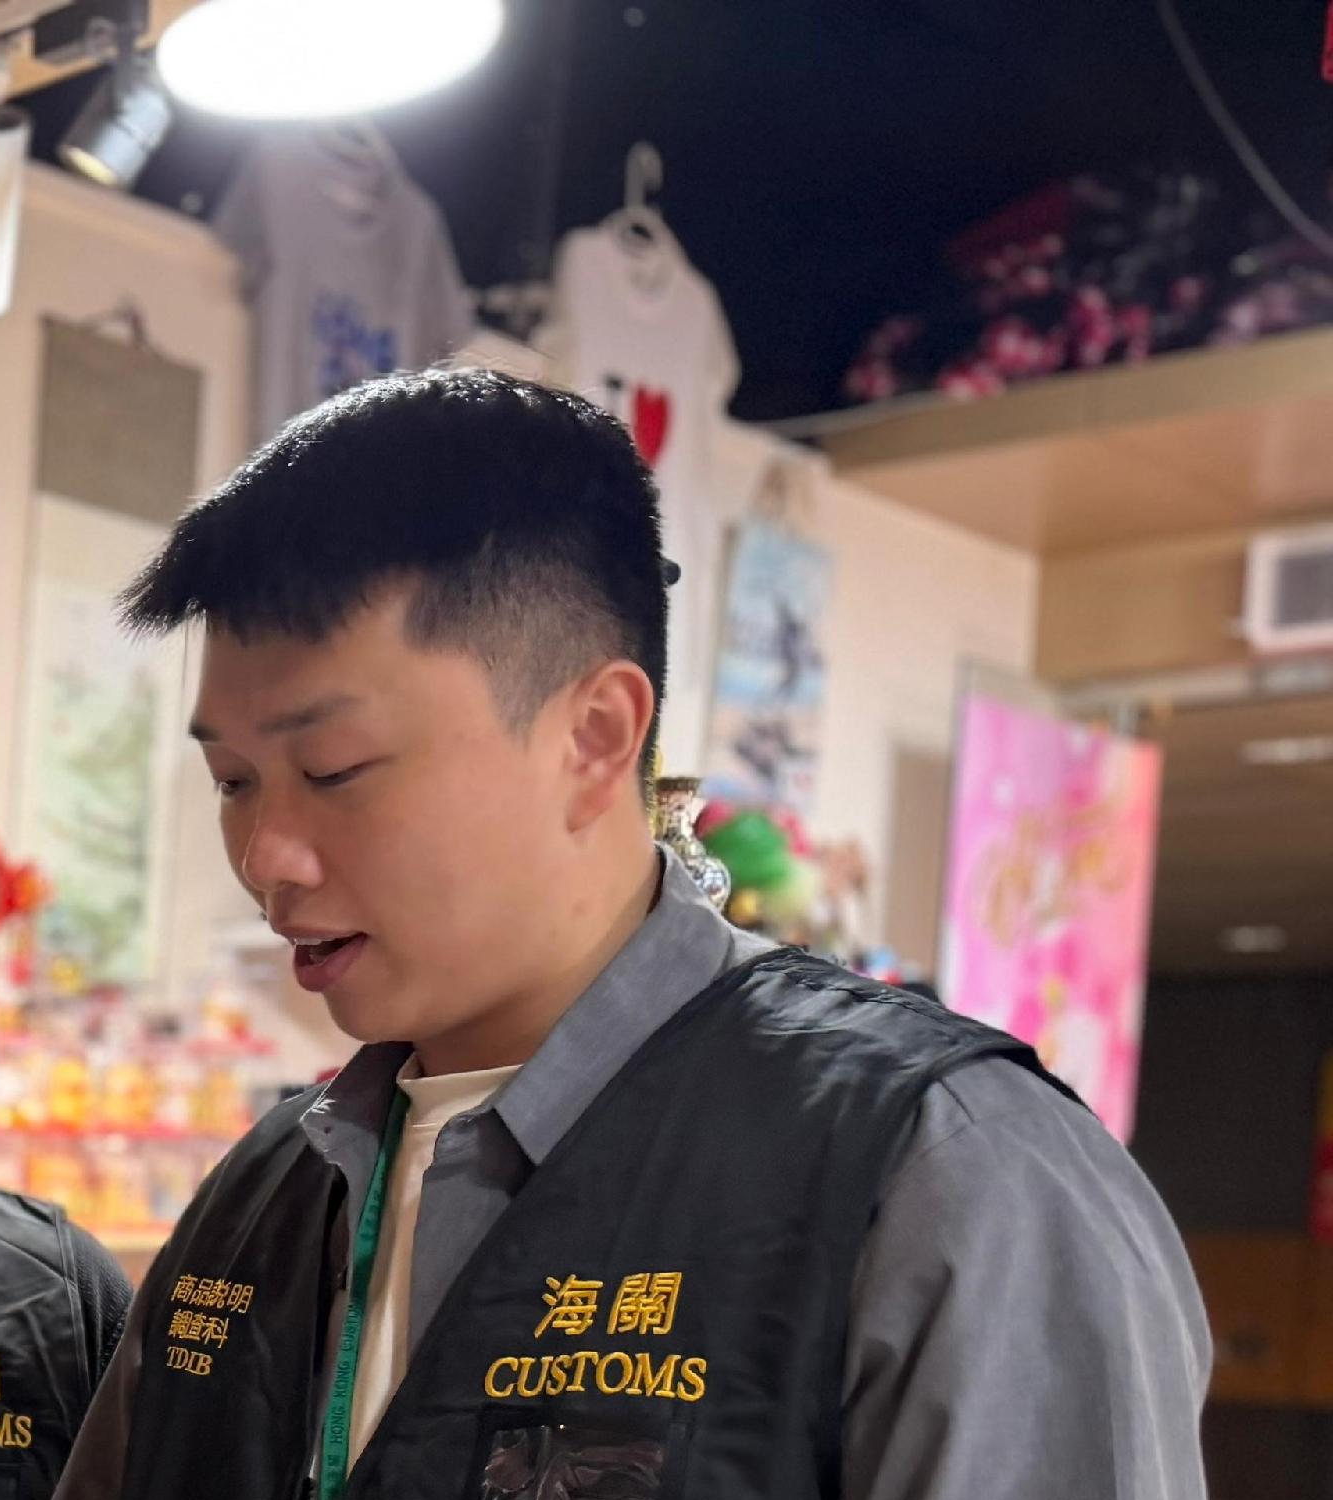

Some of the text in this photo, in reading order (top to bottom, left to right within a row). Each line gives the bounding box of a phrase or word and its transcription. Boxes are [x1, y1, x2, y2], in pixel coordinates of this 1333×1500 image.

[535, 1271, 683, 1339] 海關
[168, 1309, 229, 1348] 調查科
[166, 1346, 213, 1375] TDIB
[333, 1360, 350, 1400] KONG
[485, 1351, 707, 1402] CUSTOMS
[330, 1405, 346, 1445] HONG
